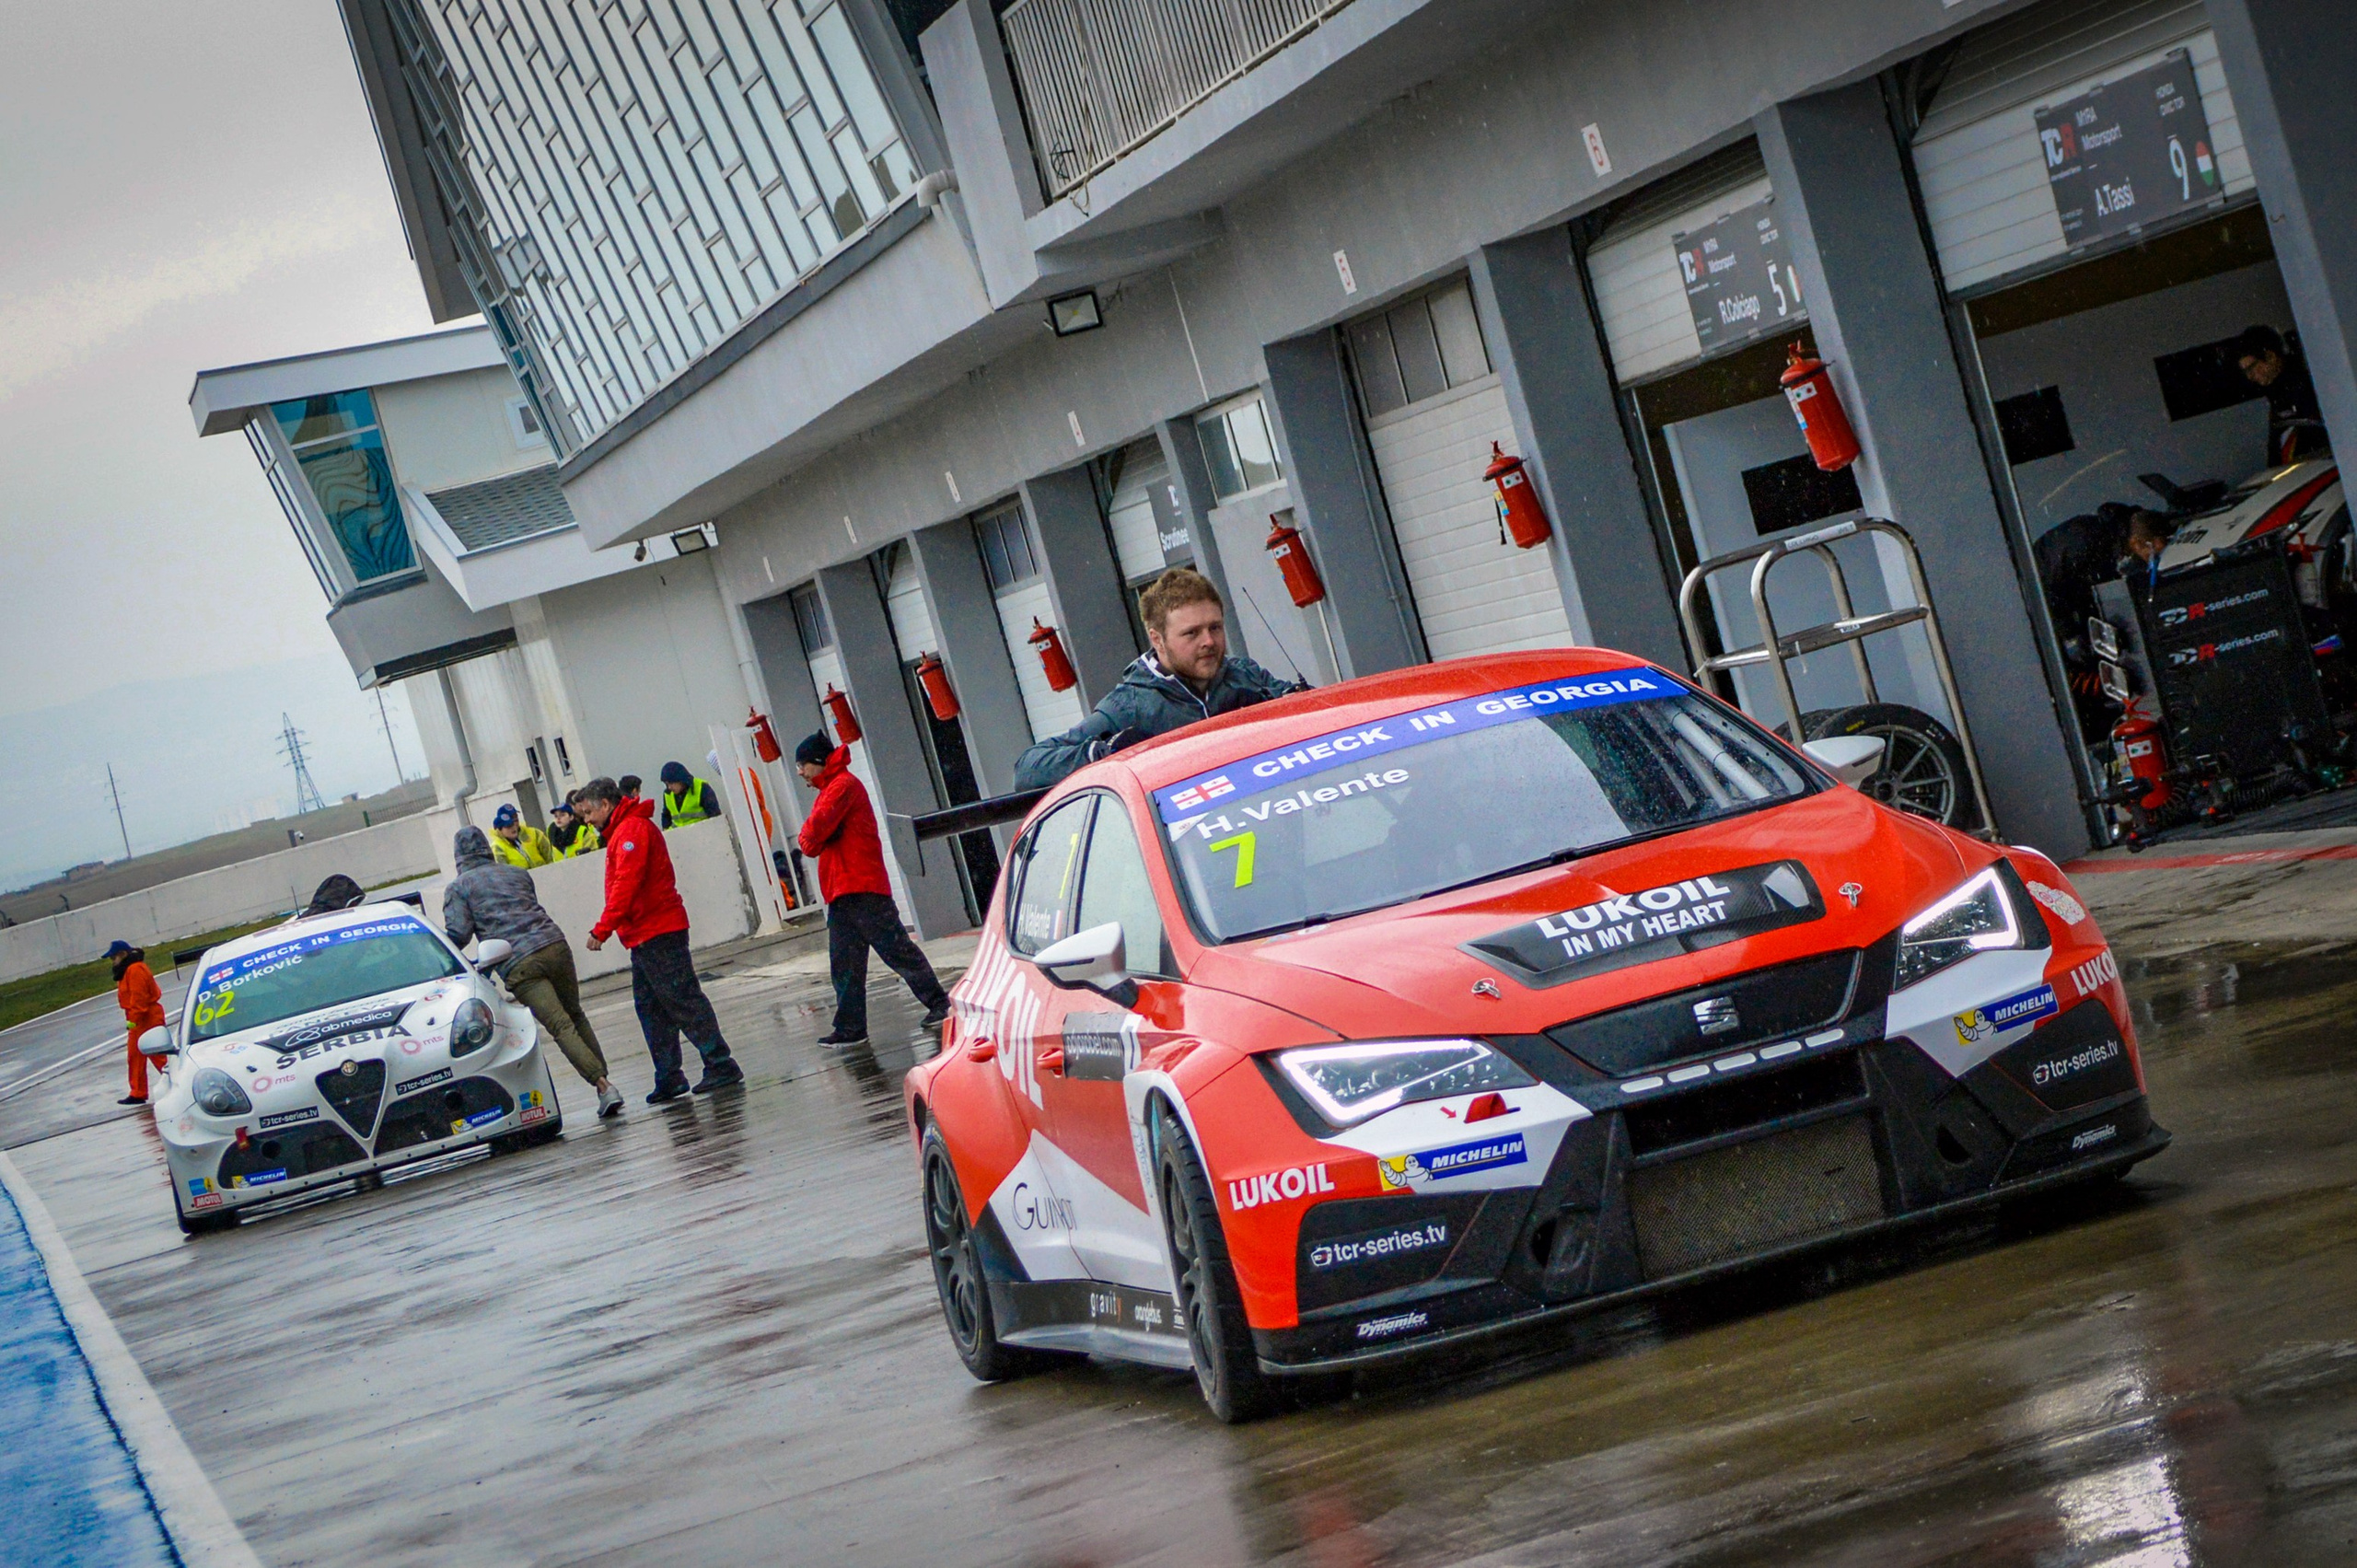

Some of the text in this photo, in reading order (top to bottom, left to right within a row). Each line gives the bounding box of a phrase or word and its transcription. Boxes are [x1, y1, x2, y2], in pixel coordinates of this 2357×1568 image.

[2040, 122, 2077, 168] TCR
[2169, 138, 2189, 201] 9
[2095, 177, 2135, 217] A.Tassi
[1678, 248, 1704, 284] TCR
[1767, 263, 1787, 316] 5
[1252, 678, 1658, 778] CHECK IN GEORGIA
[1209, 830, 1257, 889] 7
[1535, 876, 1731, 939] LUKOIL
[242, 942, 302, 969] CHECK
[311, 935, 331, 947] IN
[340, 922, 420, 939] GEORGIA
[1562, 900, 1727, 958] IN MY HEART
[193, 990, 236, 1028] 62
[1994, 991, 2054, 1022] MICHELIN
[276, 1025, 412, 1070] SERBIA
[423, 1035, 444, 1046] mts
[2049, 1040, 2119, 1078] tcr-series.tv
[274, 1074, 296, 1085] mts
[407, 1069, 453, 1091] tcr-series.tv
[271, 1108, 318, 1125] tcr-series.tv
[471, 1109, 502, 1123] MICHELIN
[521, 1109, 544, 1121] MOTUL
[1431, 1139, 1524, 1169] MICHELIN
[250, 1171, 285, 1183] MICHELIN
[1229, 1163, 1334, 1211] LUKOIL
[195, 1194, 222, 1208] MOTUL
[1333, 1224, 1446, 1263] tcr-series.tv
[1090, 1290, 1121, 1324] gravity
[1357, 1311, 1427, 1337] Dynamics
